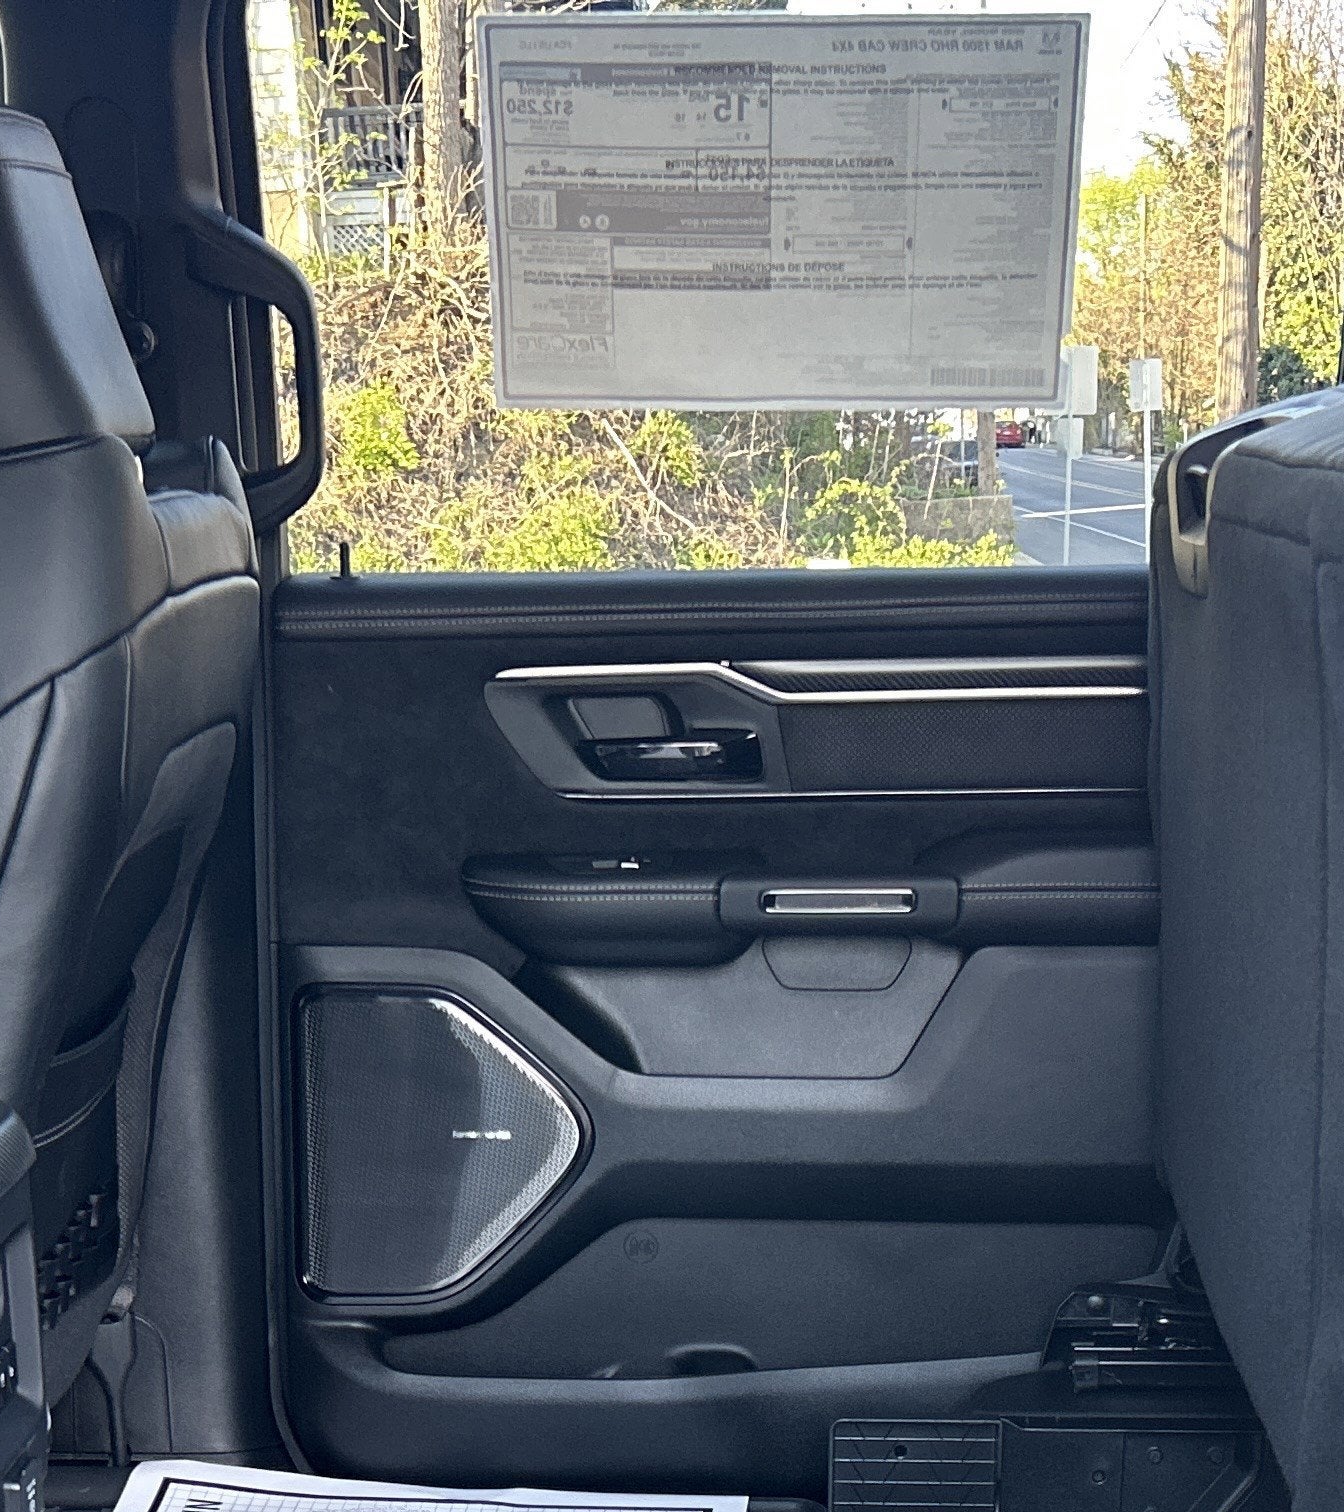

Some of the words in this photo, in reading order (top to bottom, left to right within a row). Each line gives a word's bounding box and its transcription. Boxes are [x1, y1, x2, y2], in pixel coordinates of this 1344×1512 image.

[810, 64, 886, 75] INSTRUCTIONS
[712, 263, 785, 273] INSTRUCTIONS
[787, 263, 802, 273] DE
